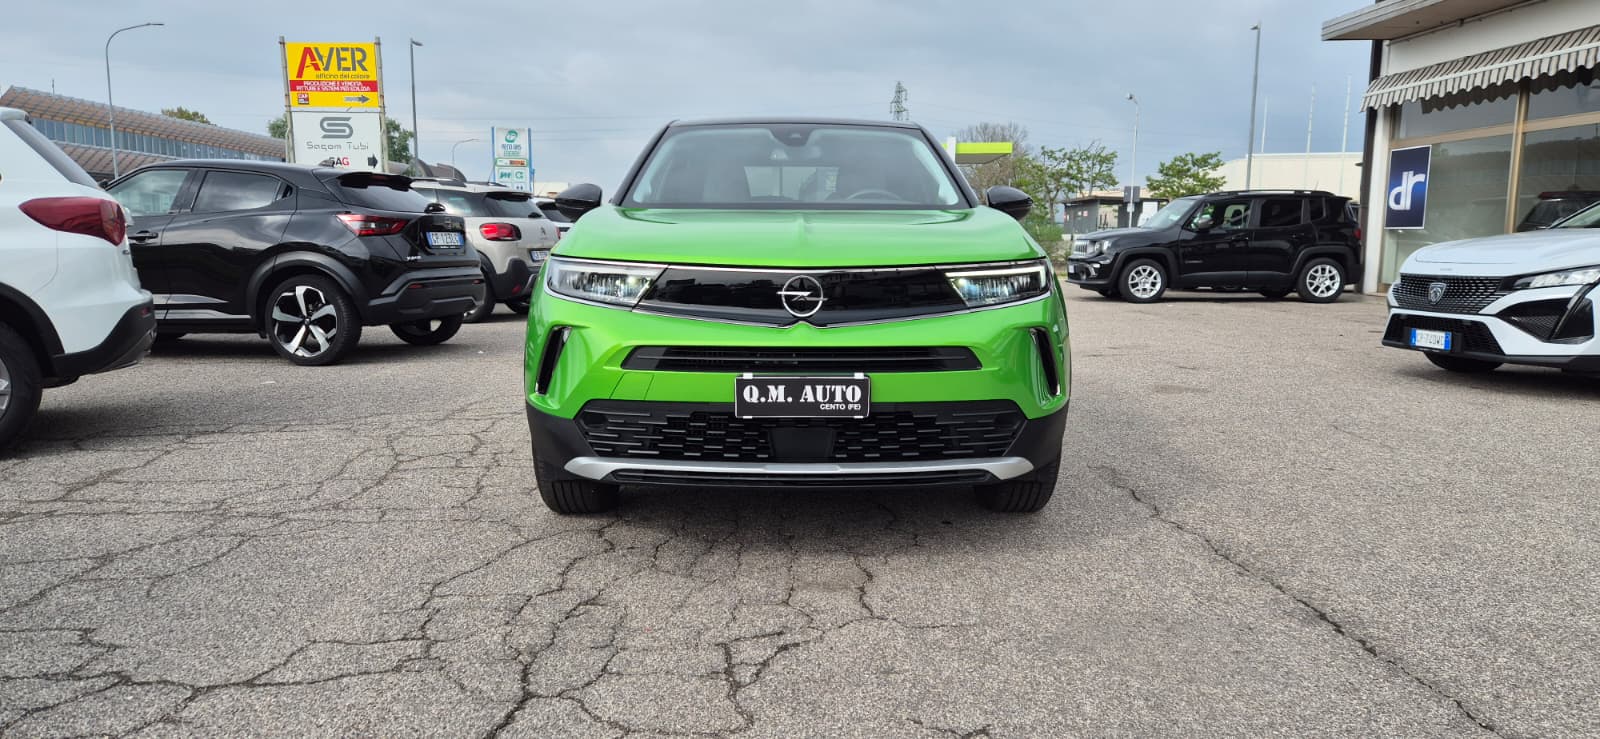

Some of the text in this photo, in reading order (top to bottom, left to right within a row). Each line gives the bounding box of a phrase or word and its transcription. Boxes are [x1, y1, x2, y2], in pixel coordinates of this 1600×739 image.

[296, 46, 368, 79] AVER
[346, 141, 369, 150] Tubi
[1389, 170, 1426, 211] dr
[743, 384, 862, 403] Q.M. AUTO
[847, 403, 861, 411] (FE)
